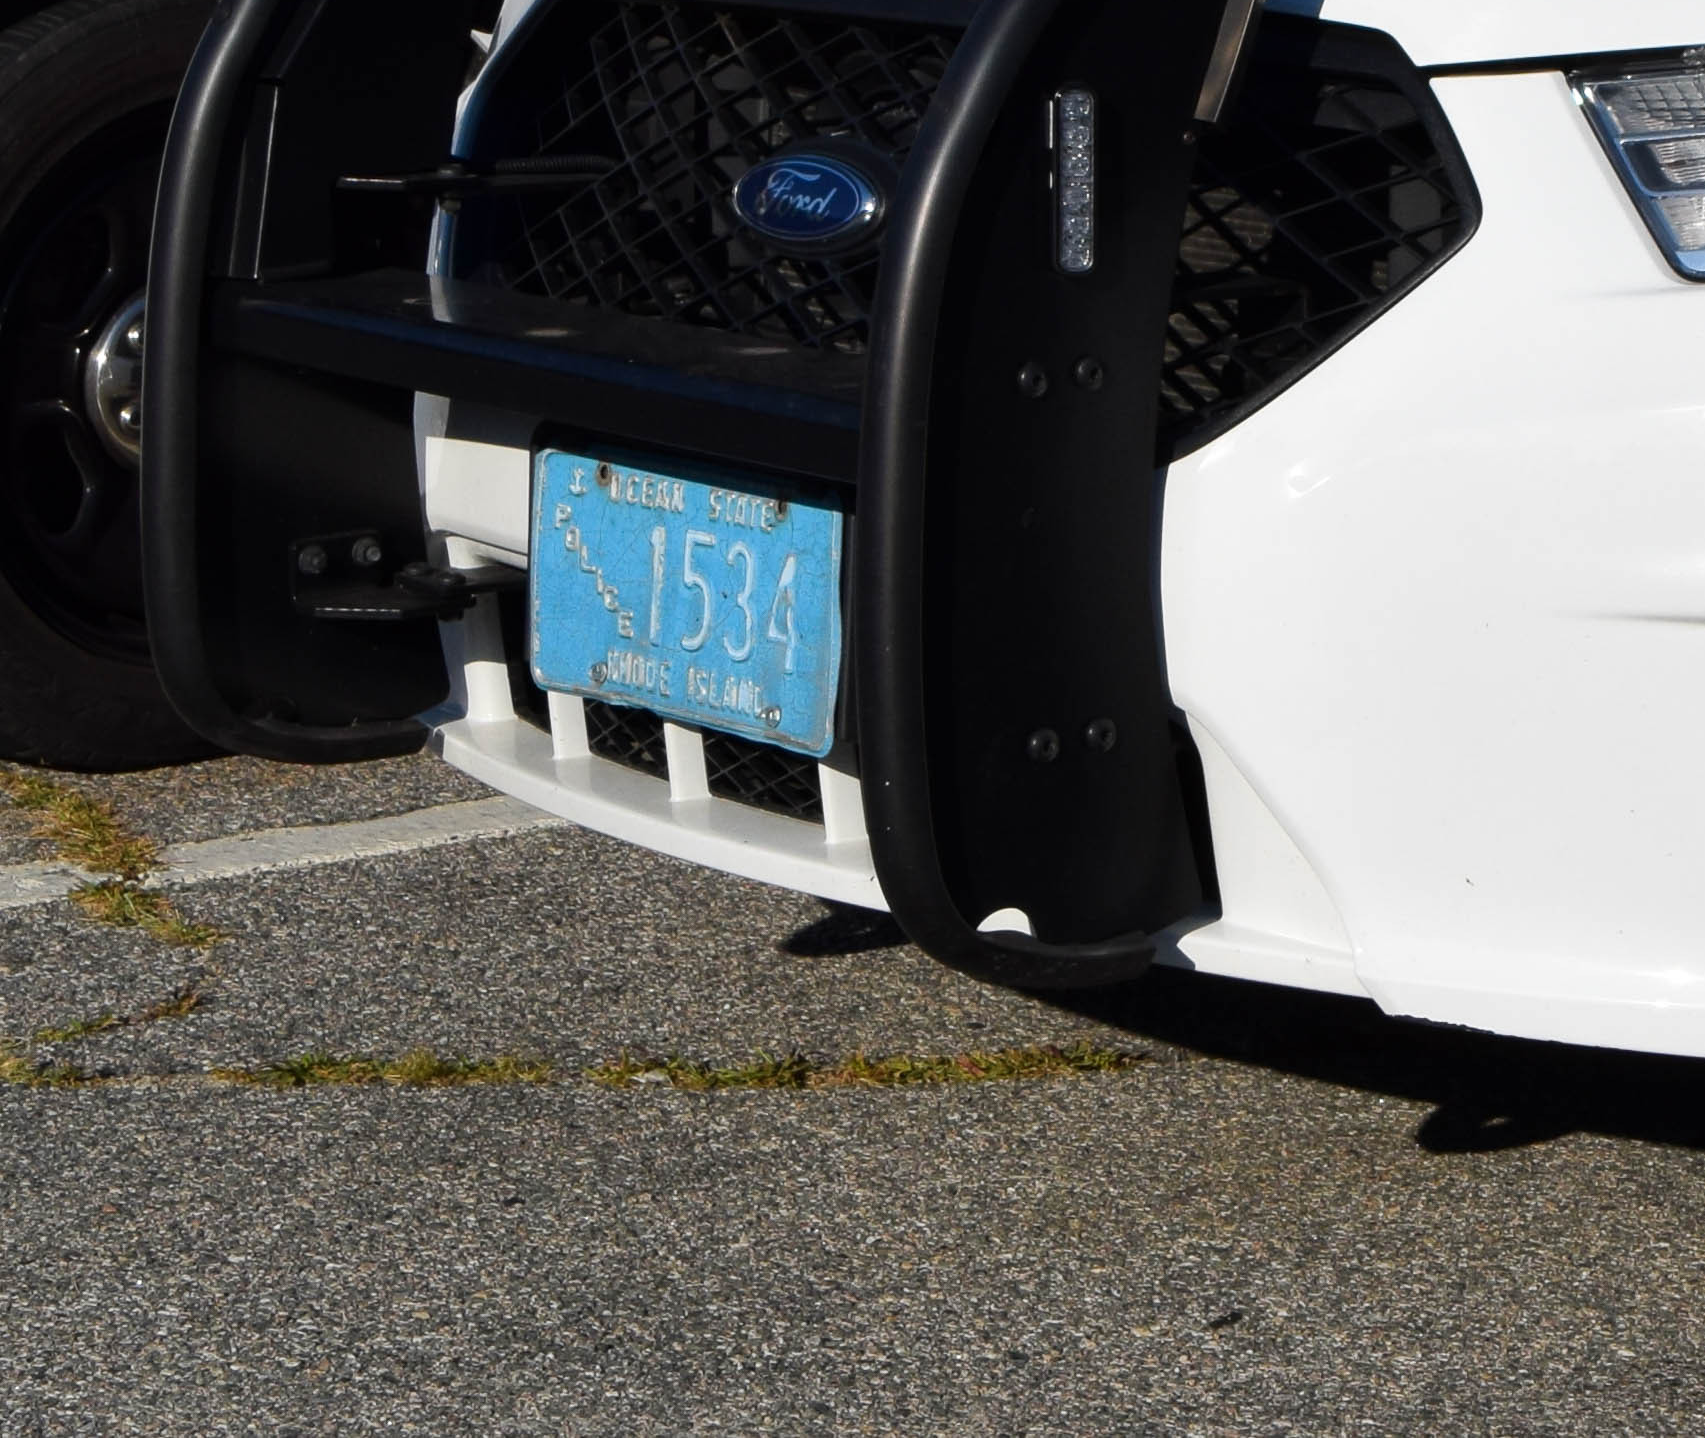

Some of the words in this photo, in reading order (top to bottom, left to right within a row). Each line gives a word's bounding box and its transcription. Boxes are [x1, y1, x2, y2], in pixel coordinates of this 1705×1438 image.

[755, 167, 838, 223] Ford
[609, 472, 685, 513] OCEAN
[708, 488, 777, 535] STATE
[554, 503, 635, 639] POLICE
[649, 524, 798, 675] 1534
[606, 649, 672, 698] RHODE
